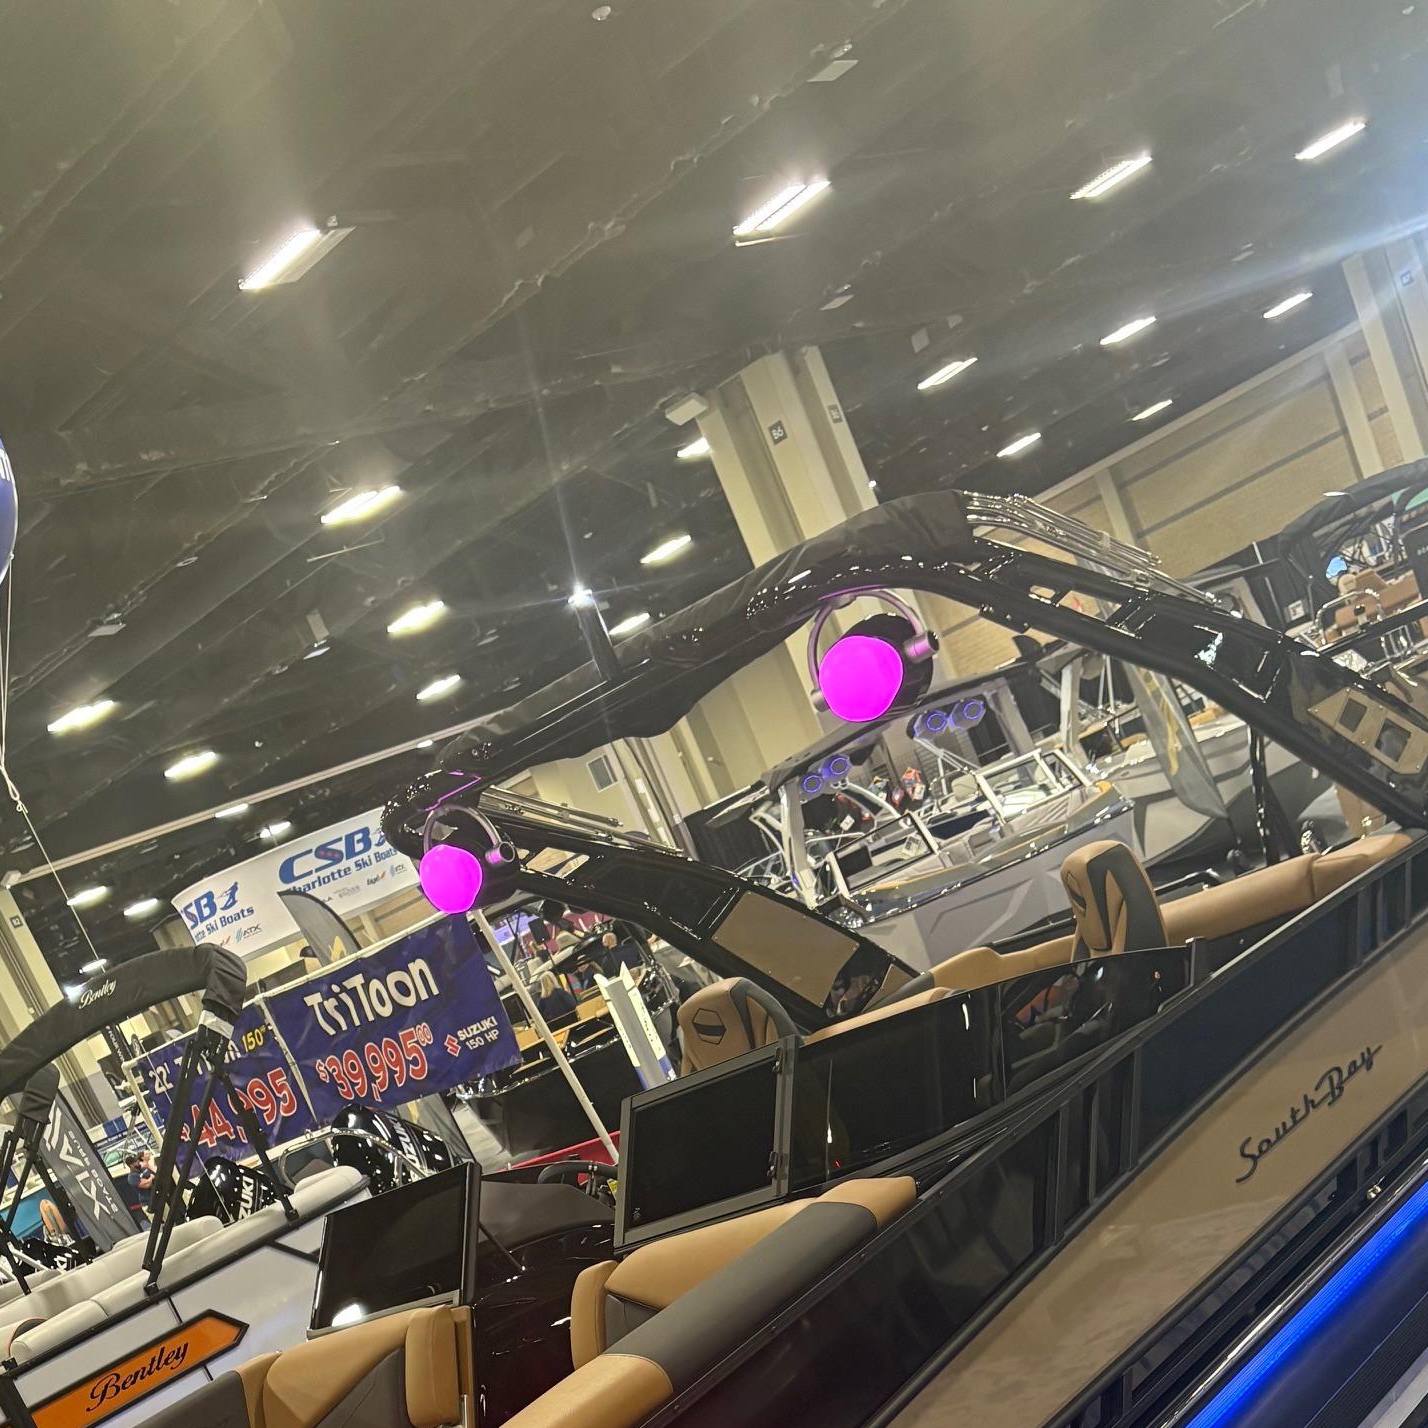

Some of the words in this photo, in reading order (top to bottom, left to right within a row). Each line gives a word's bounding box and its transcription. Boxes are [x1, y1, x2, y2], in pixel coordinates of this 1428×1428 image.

[278, 826, 372, 885] CSB
[289, 866, 352, 894] harlotte
[354, 852, 373, 872] Ski
[205, 920, 219, 936] Ski
[219, 906, 255, 928] Boats
[78, 979, 117, 1010] Bentley
[303, 958, 440, 1037] TriToon
[456, 1015, 499, 1042] SUZUKI
[465, 1039, 484, 1051] 150
[486, 1029, 500, 1043] HP
[1235, 1093, 1324, 1184] South
[1314, 1044, 1383, 1106] Bay
[85, 1342, 189, 1413] Bentley
